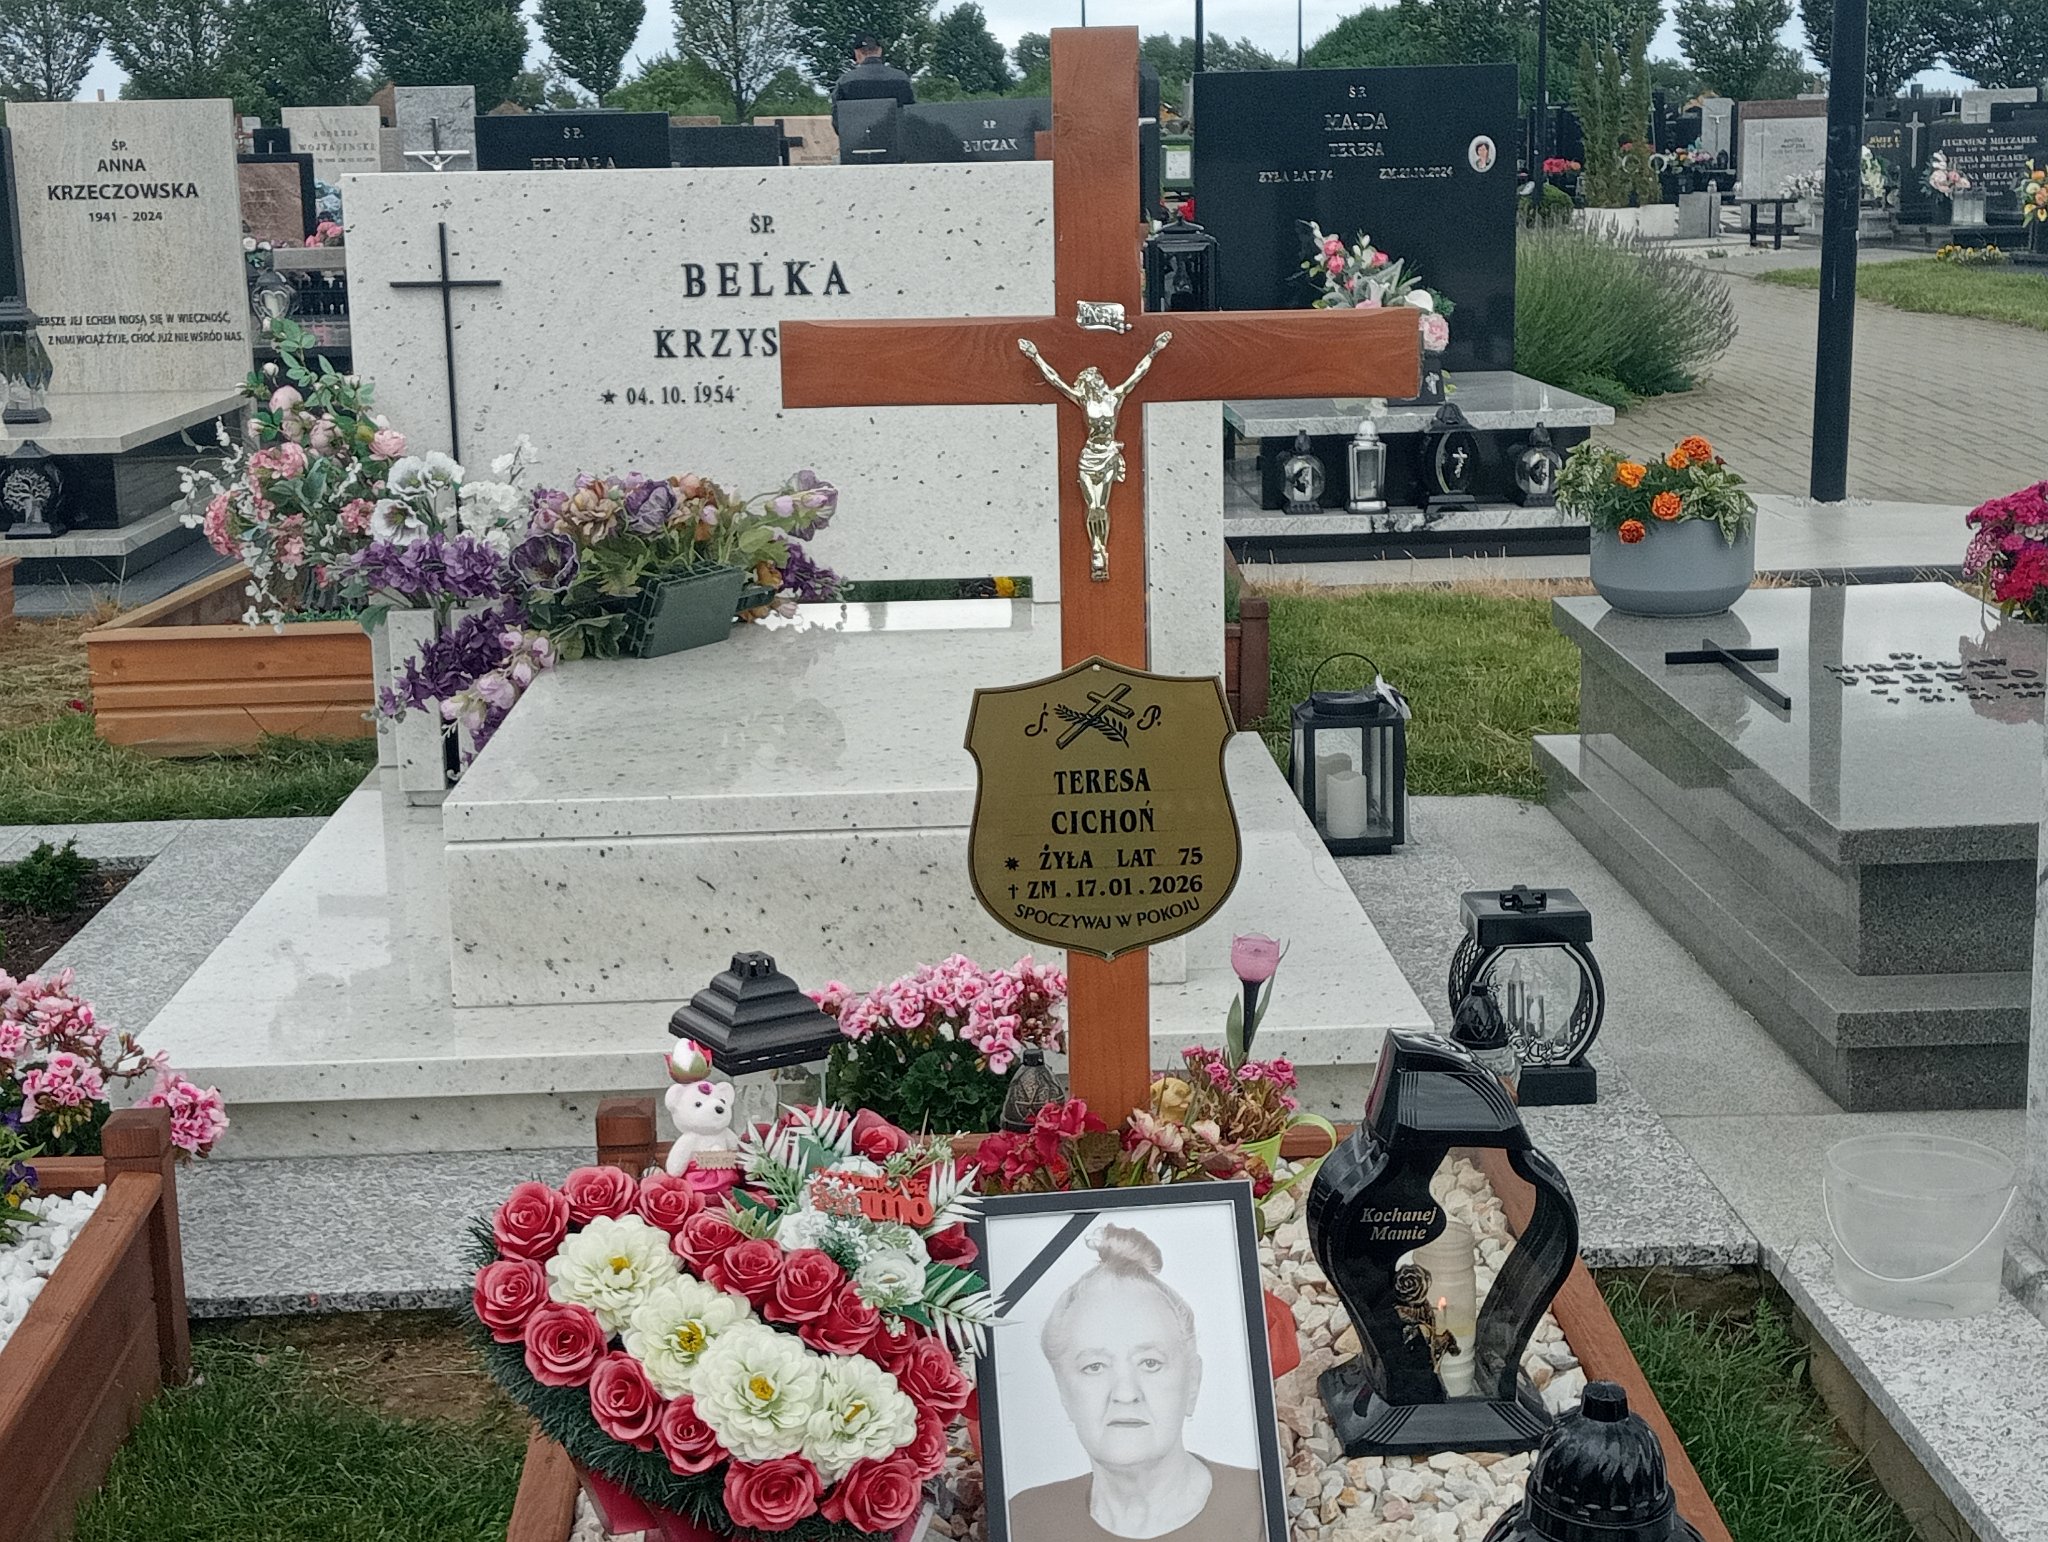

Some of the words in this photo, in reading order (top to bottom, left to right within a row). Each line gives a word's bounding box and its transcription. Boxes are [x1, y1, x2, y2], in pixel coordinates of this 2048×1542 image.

[1328, 142, 1385, 157] TERESA
[97, 158, 146, 172] ANNA
[48, 183, 199, 201] KRZECZOWSKA
[89, 212, 117, 222] 1941
[133, 211, 163, 222] 2024
[681, 261, 850, 298] BELKA
[36, 316, 66, 327] ERSZE
[70, 315, 83, 326] JEJ
[86, 315, 116, 325] ECHEM
[166, 313, 174, 323] W
[48, 335, 54, 345] Z
[653, 326, 778, 359] KRZYS
[1054, 767, 1151, 795] TERESA
[1051, 800, 1155, 835] CICHOŃ
[1039, 843, 1094, 871] ŻYŁA
[1117, 848, 1157, 868] LAT
[1178, 846, 1204, 866] 75
[1014, 903, 1111, 930] SPOCZYWAJ
[1116, 914, 1132, 929] W
[1137, 896, 1201, 927] POKOJU
[1360, 1206, 1437, 1226] Kochanej
[1369, 1225, 1427, 1241] Mamie
